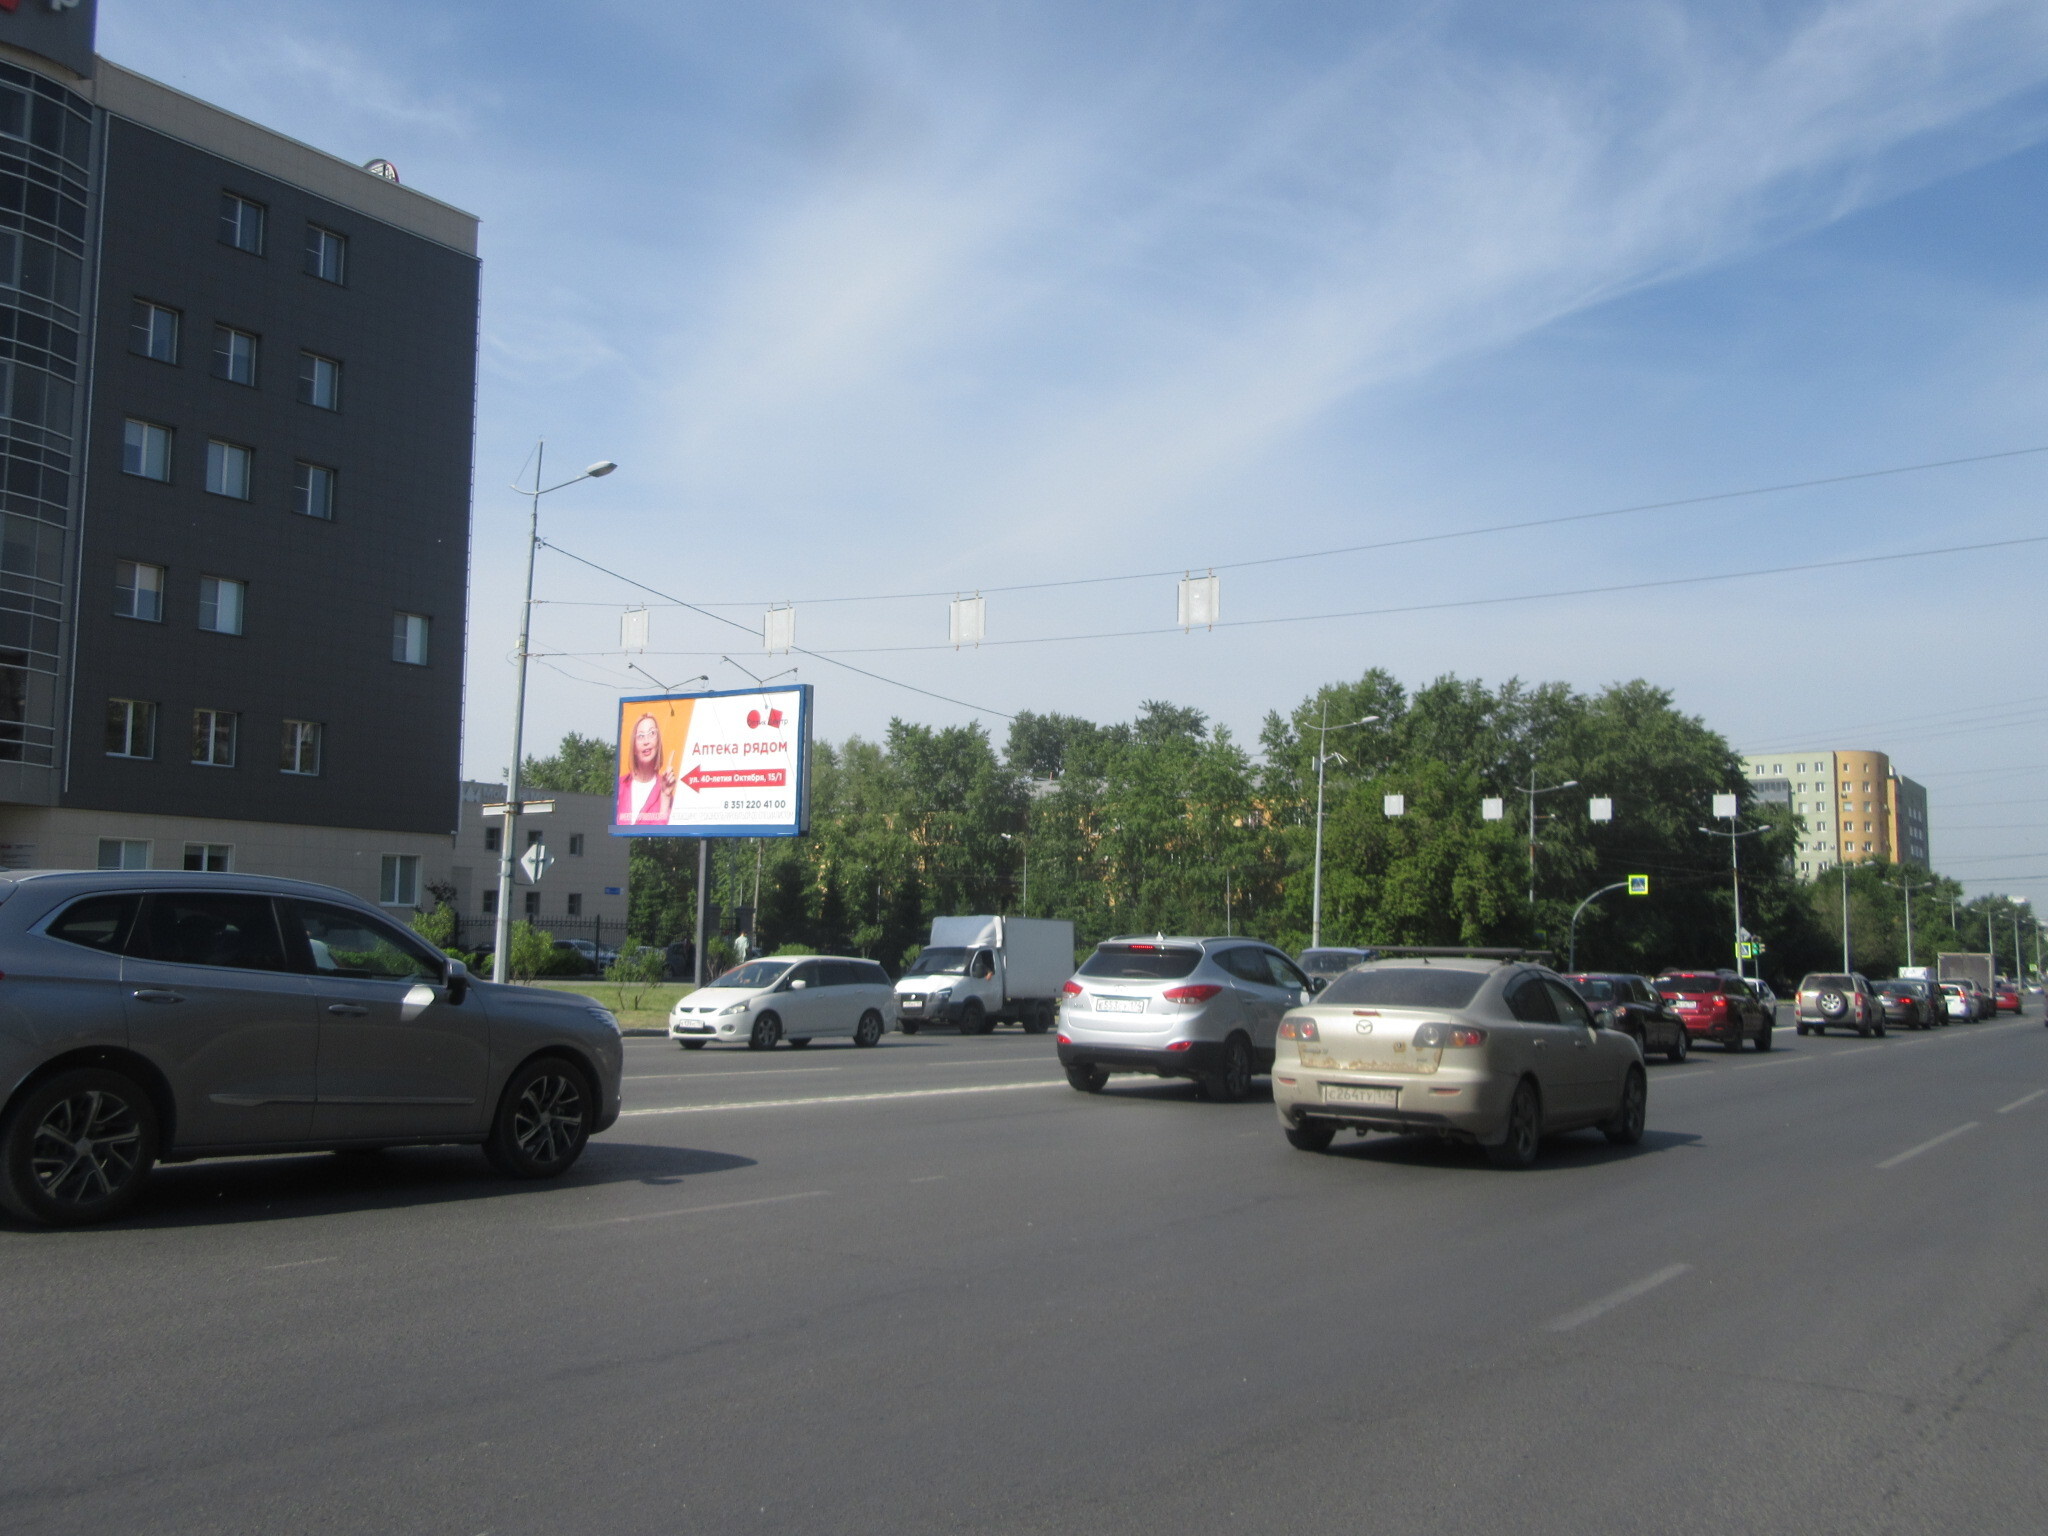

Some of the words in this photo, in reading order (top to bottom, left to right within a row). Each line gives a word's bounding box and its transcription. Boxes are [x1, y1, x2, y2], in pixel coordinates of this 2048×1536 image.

[692, 742, 739, 756] Аптека
[743, 741, 788, 756] рядом
[689, 776, 700, 785] ул.
[701, 774, 732, 783] 40-летия
[733, 772, 767, 783] Октября,
[768, 772, 783, 782] 15/1
[723, 800, 729, 809] 8
[731, 800, 744, 809] 351
[746, 800, 761, 809] 220
[763, 800, 772, 809] 41
[774, 799, 786, 808] 00
